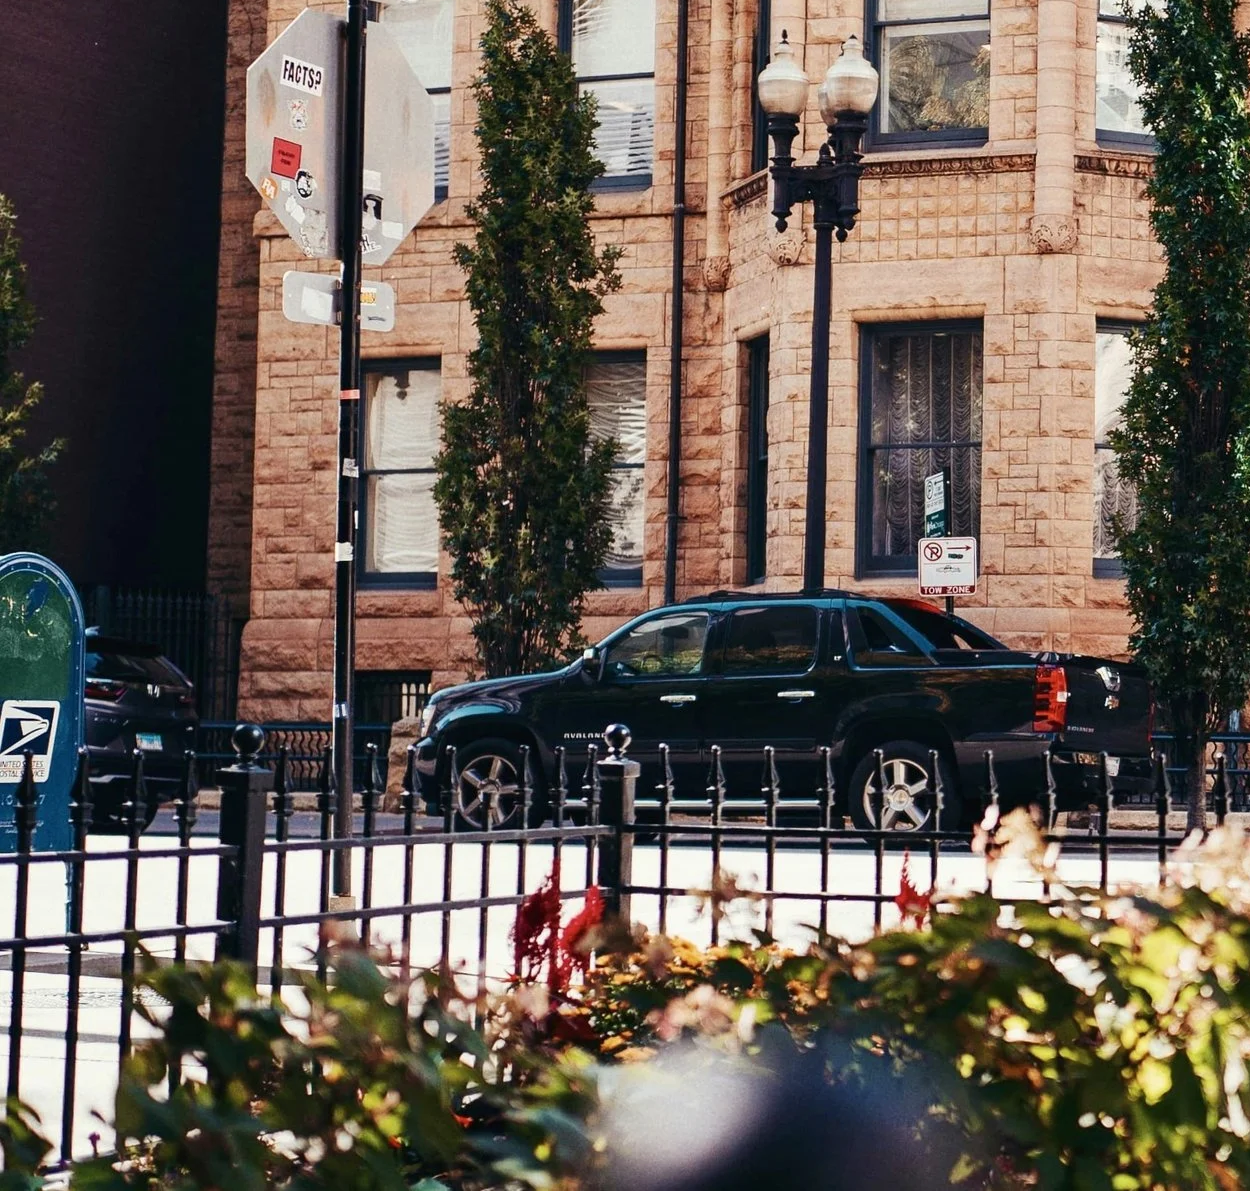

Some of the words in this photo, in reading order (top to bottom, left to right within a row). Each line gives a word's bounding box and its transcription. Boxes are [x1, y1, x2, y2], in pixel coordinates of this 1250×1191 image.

[283, 59, 322, 90] FACTS?
[924, 587, 942, 595] TOW
[947, 586, 970, 594] ZONE
[0, 760, 21, 768] NITED
[0, 770, 18, 778] OSTAL
